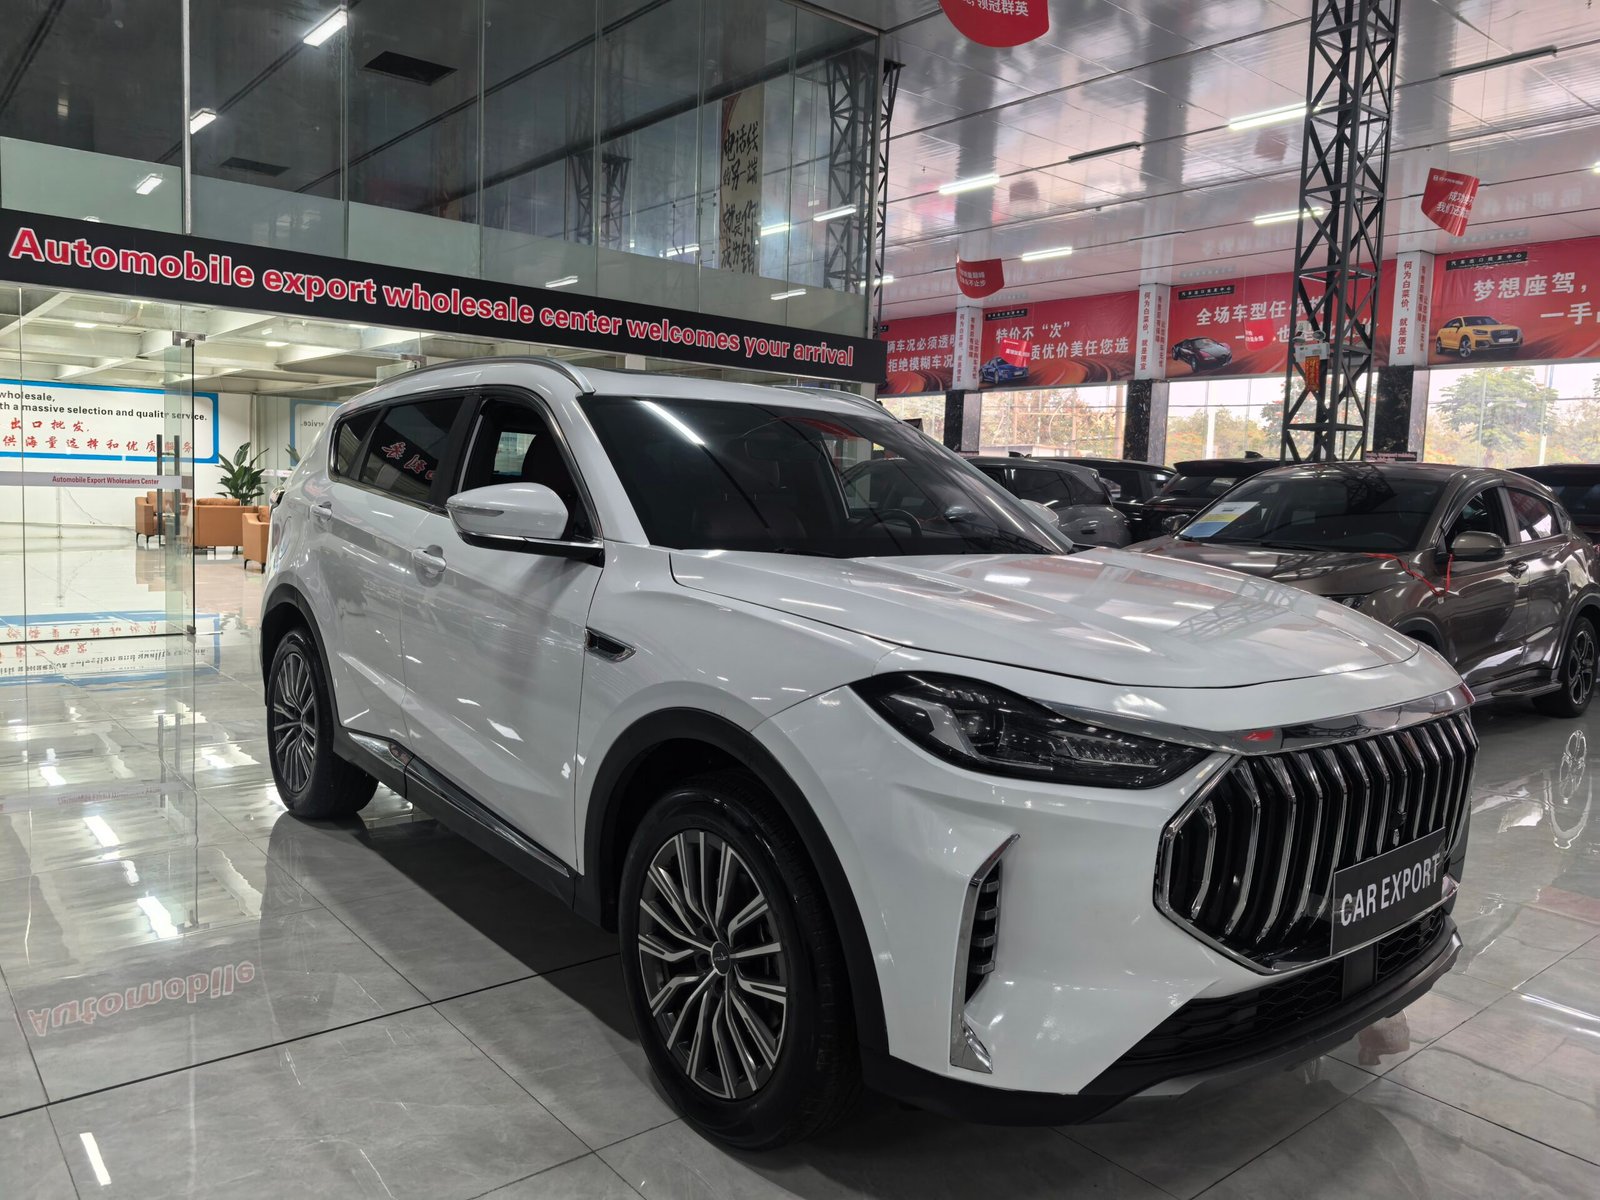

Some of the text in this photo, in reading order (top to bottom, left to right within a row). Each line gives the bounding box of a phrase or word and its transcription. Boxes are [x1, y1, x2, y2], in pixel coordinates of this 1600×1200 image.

[9, 227, 854, 367] Automobile export wholesale center welcomes your arrival
[1473, 271, 1587, 302] 梦想座驾，
[1540, 301, 1600, 325] 一手
[1030, 337, 1129, 360] 质优价美任您选
[0, 391, 55, 402] wholesale,
[21, 404, 65, 413] massive
[67, 405, 113, 416] selection
[116, 409, 134, 417] and
[52, 475, 159, 486] Automobile Export Wholesalers Center
[1340, 852, 1440, 927] CAR EXPORT
